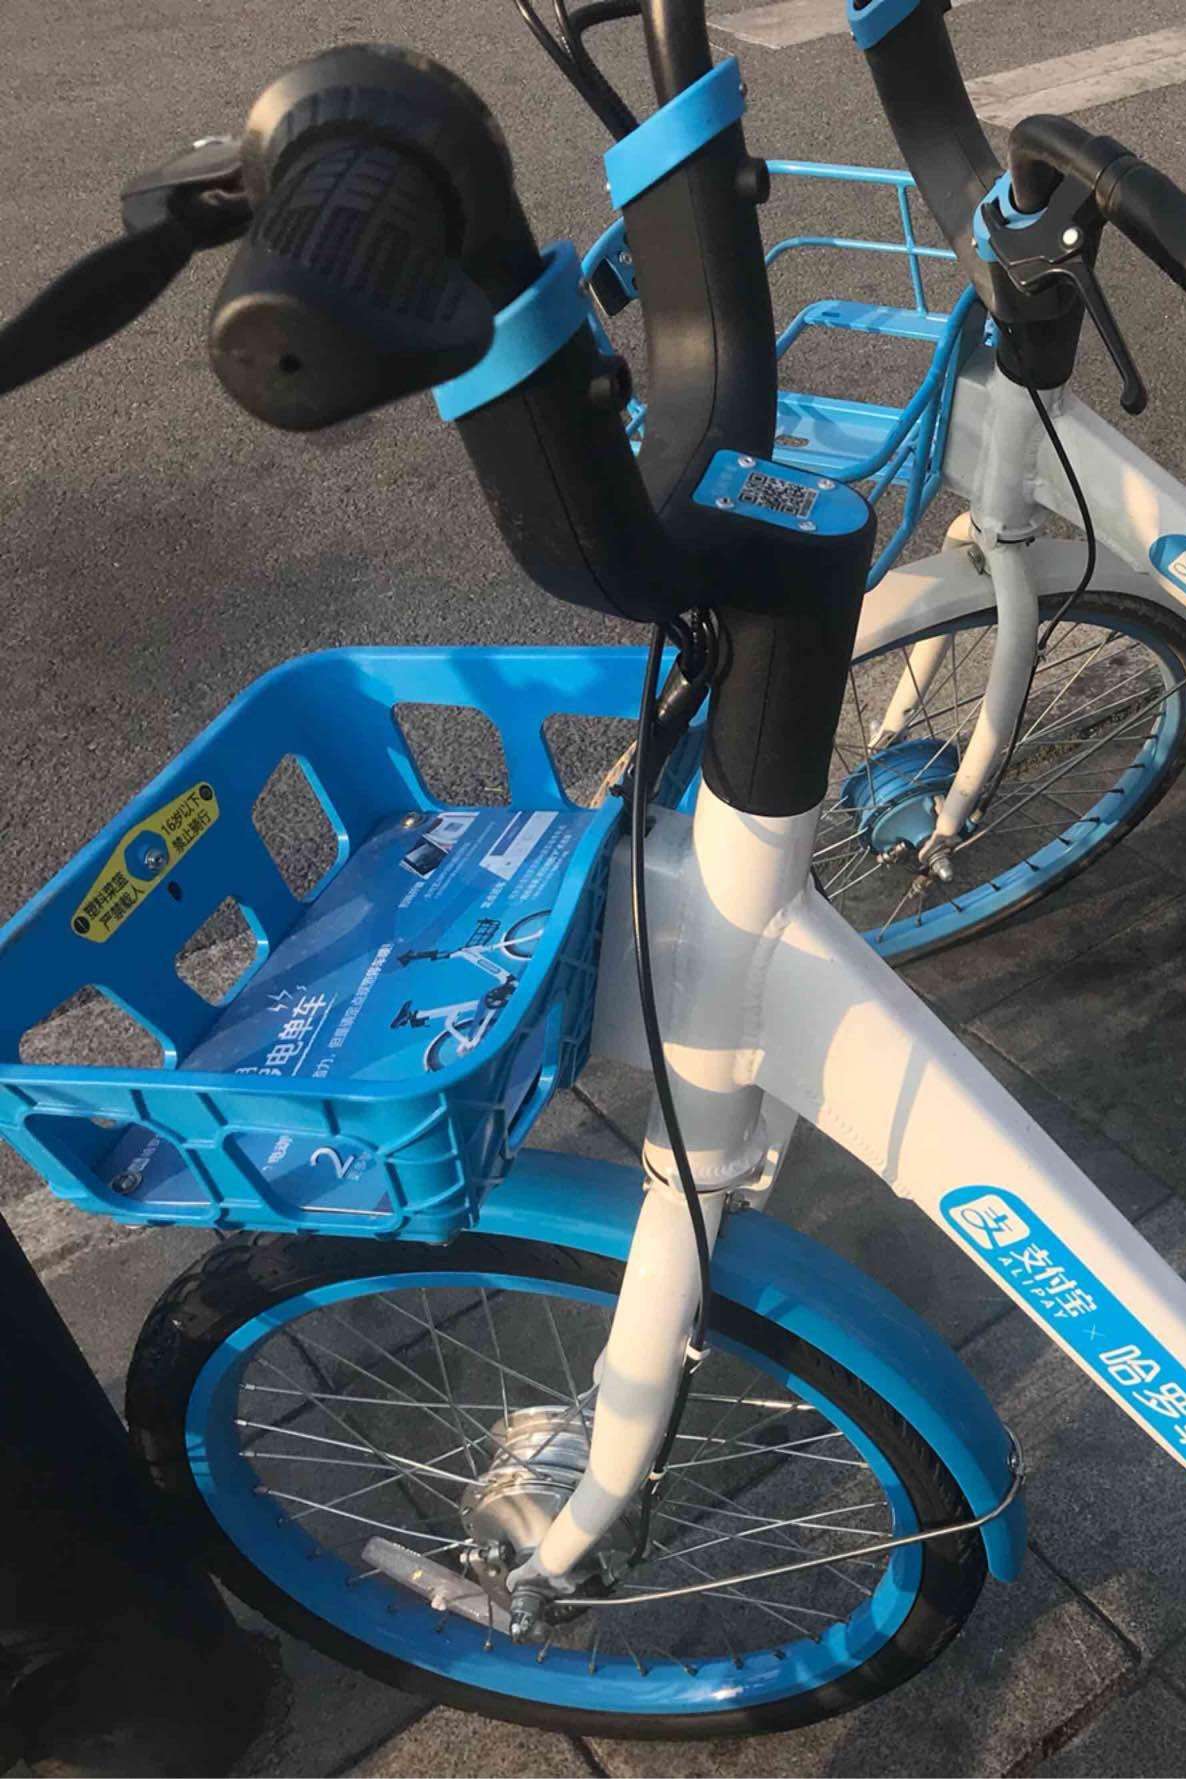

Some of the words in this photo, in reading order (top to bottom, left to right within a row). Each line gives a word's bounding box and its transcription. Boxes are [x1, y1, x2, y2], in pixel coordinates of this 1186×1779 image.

[161, 792, 201, 835] 16岁以下
[998, 1256, 1070, 1318] ALIPAY
[1011, 1243, 1098, 1317] 支付宝
